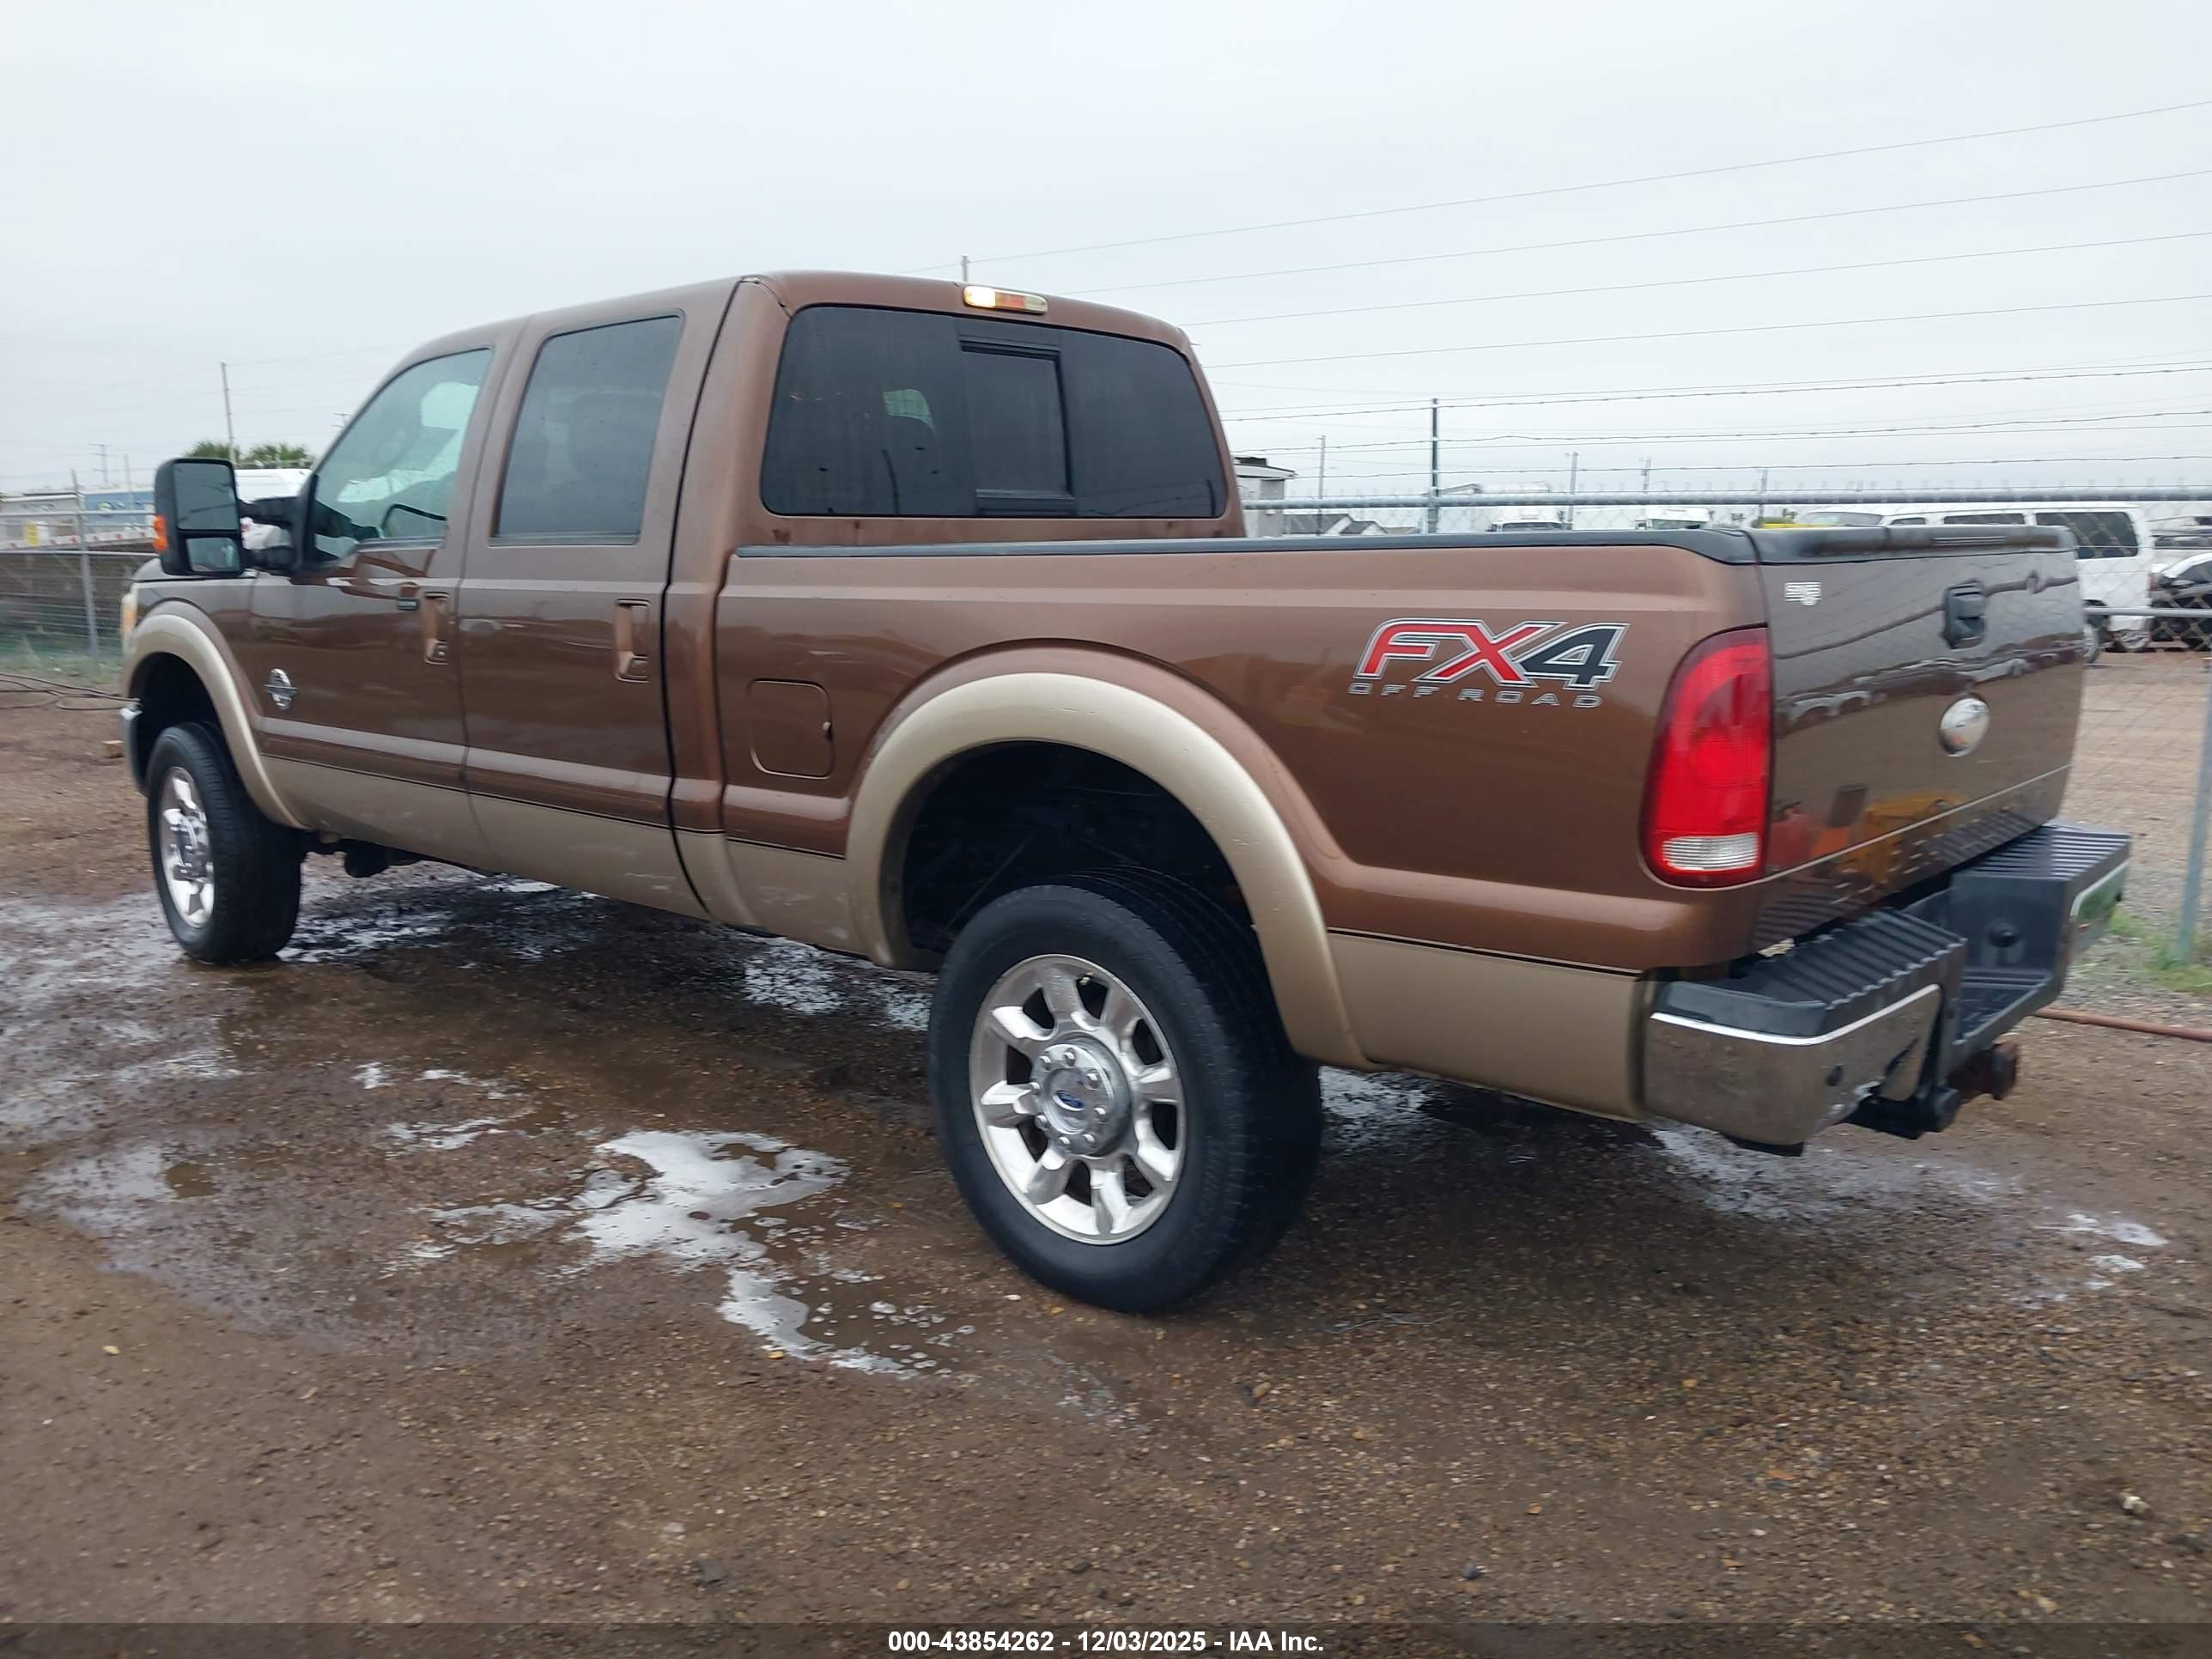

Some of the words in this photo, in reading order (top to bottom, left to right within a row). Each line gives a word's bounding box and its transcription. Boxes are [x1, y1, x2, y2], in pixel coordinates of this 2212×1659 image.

[1352, 617, 1631, 691] FX4
[1347, 683, 1440, 698] OFF
[1457, 688, 1603, 708] ROAD
